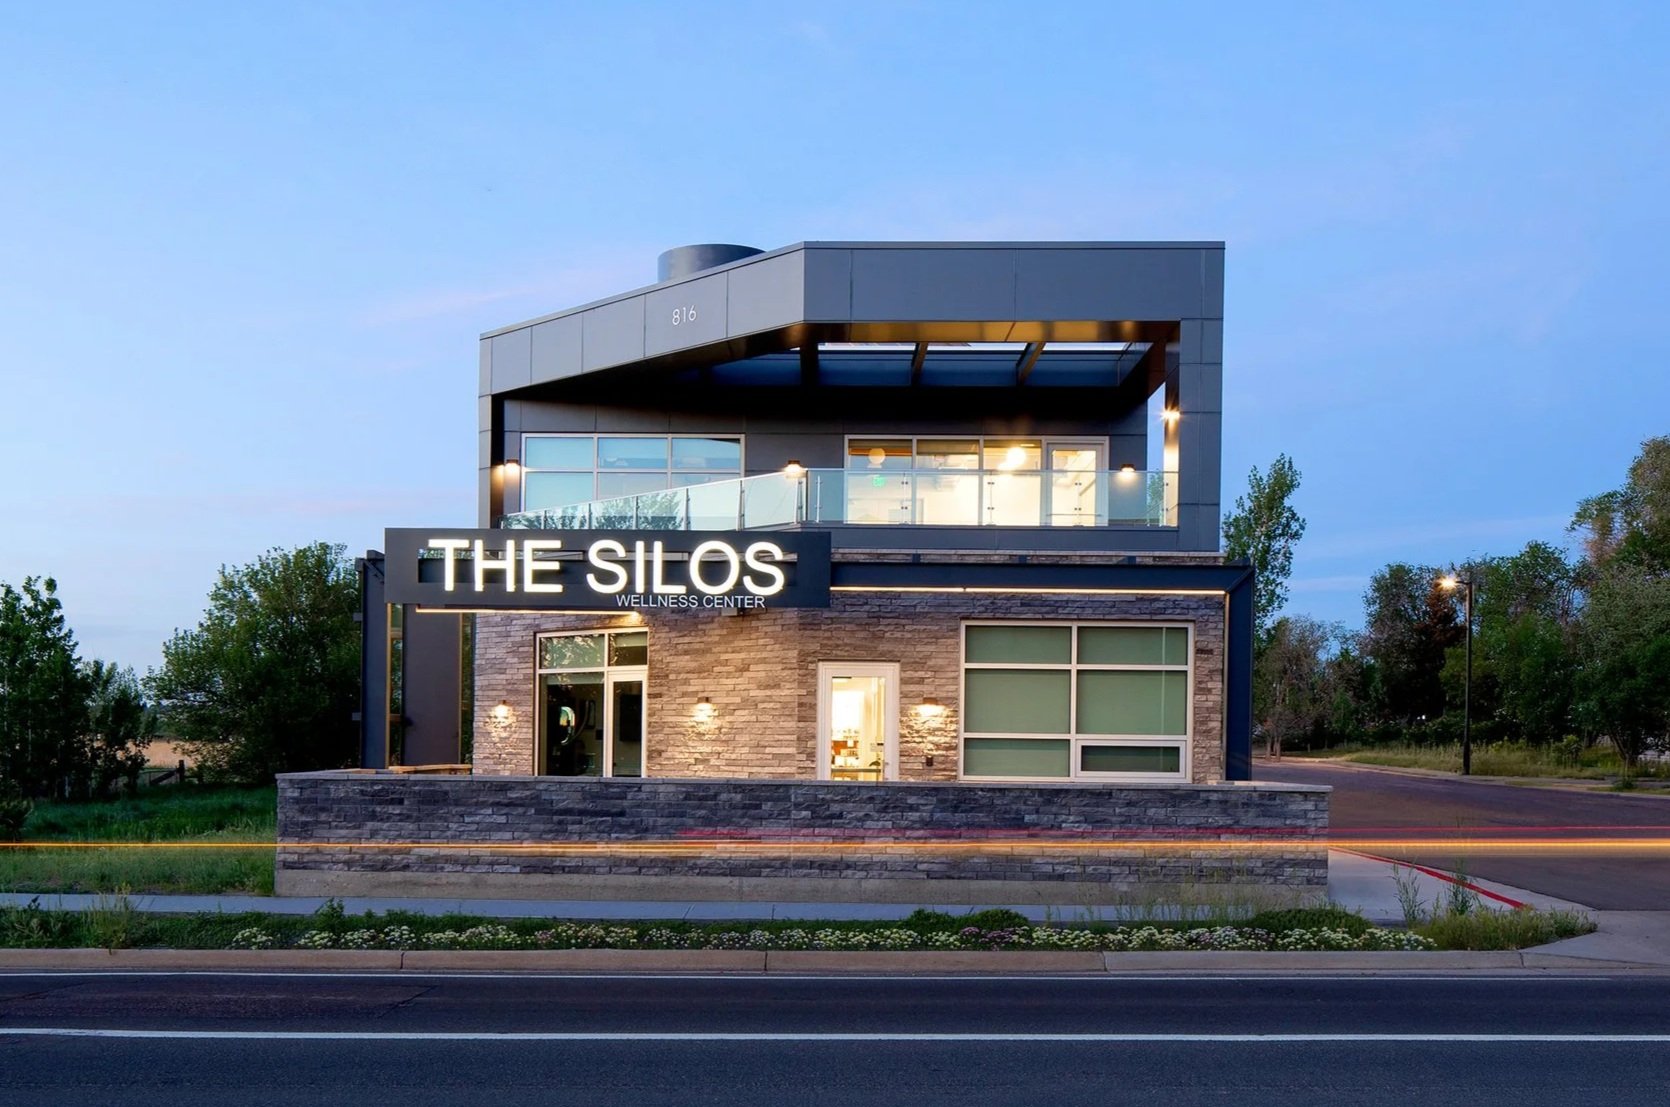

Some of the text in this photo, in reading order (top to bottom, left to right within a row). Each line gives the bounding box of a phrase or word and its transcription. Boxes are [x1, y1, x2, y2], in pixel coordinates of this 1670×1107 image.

[672, 305, 697, 325] 816
[428, 539, 785, 595] THE SILOS
[616, 594, 766, 608] WELLNESS CENTER
